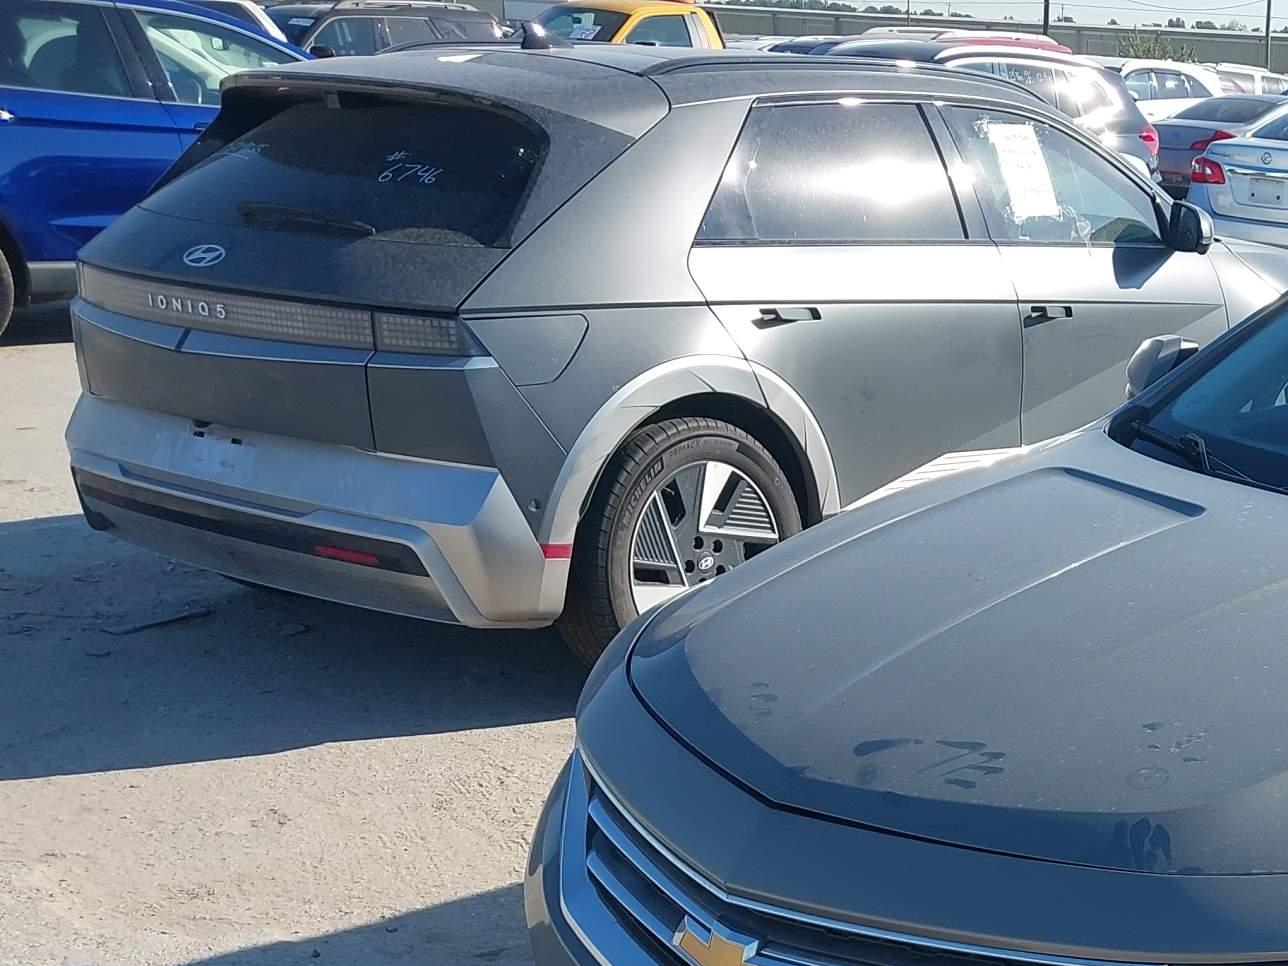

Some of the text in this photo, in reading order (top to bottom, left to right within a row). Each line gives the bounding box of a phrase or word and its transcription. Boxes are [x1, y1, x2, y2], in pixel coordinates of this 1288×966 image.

[378, 163, 443, 184] 6746
[148, 293, 226, 319] IONIQ 5
[622, 457, 664, 526] MICHELIN
